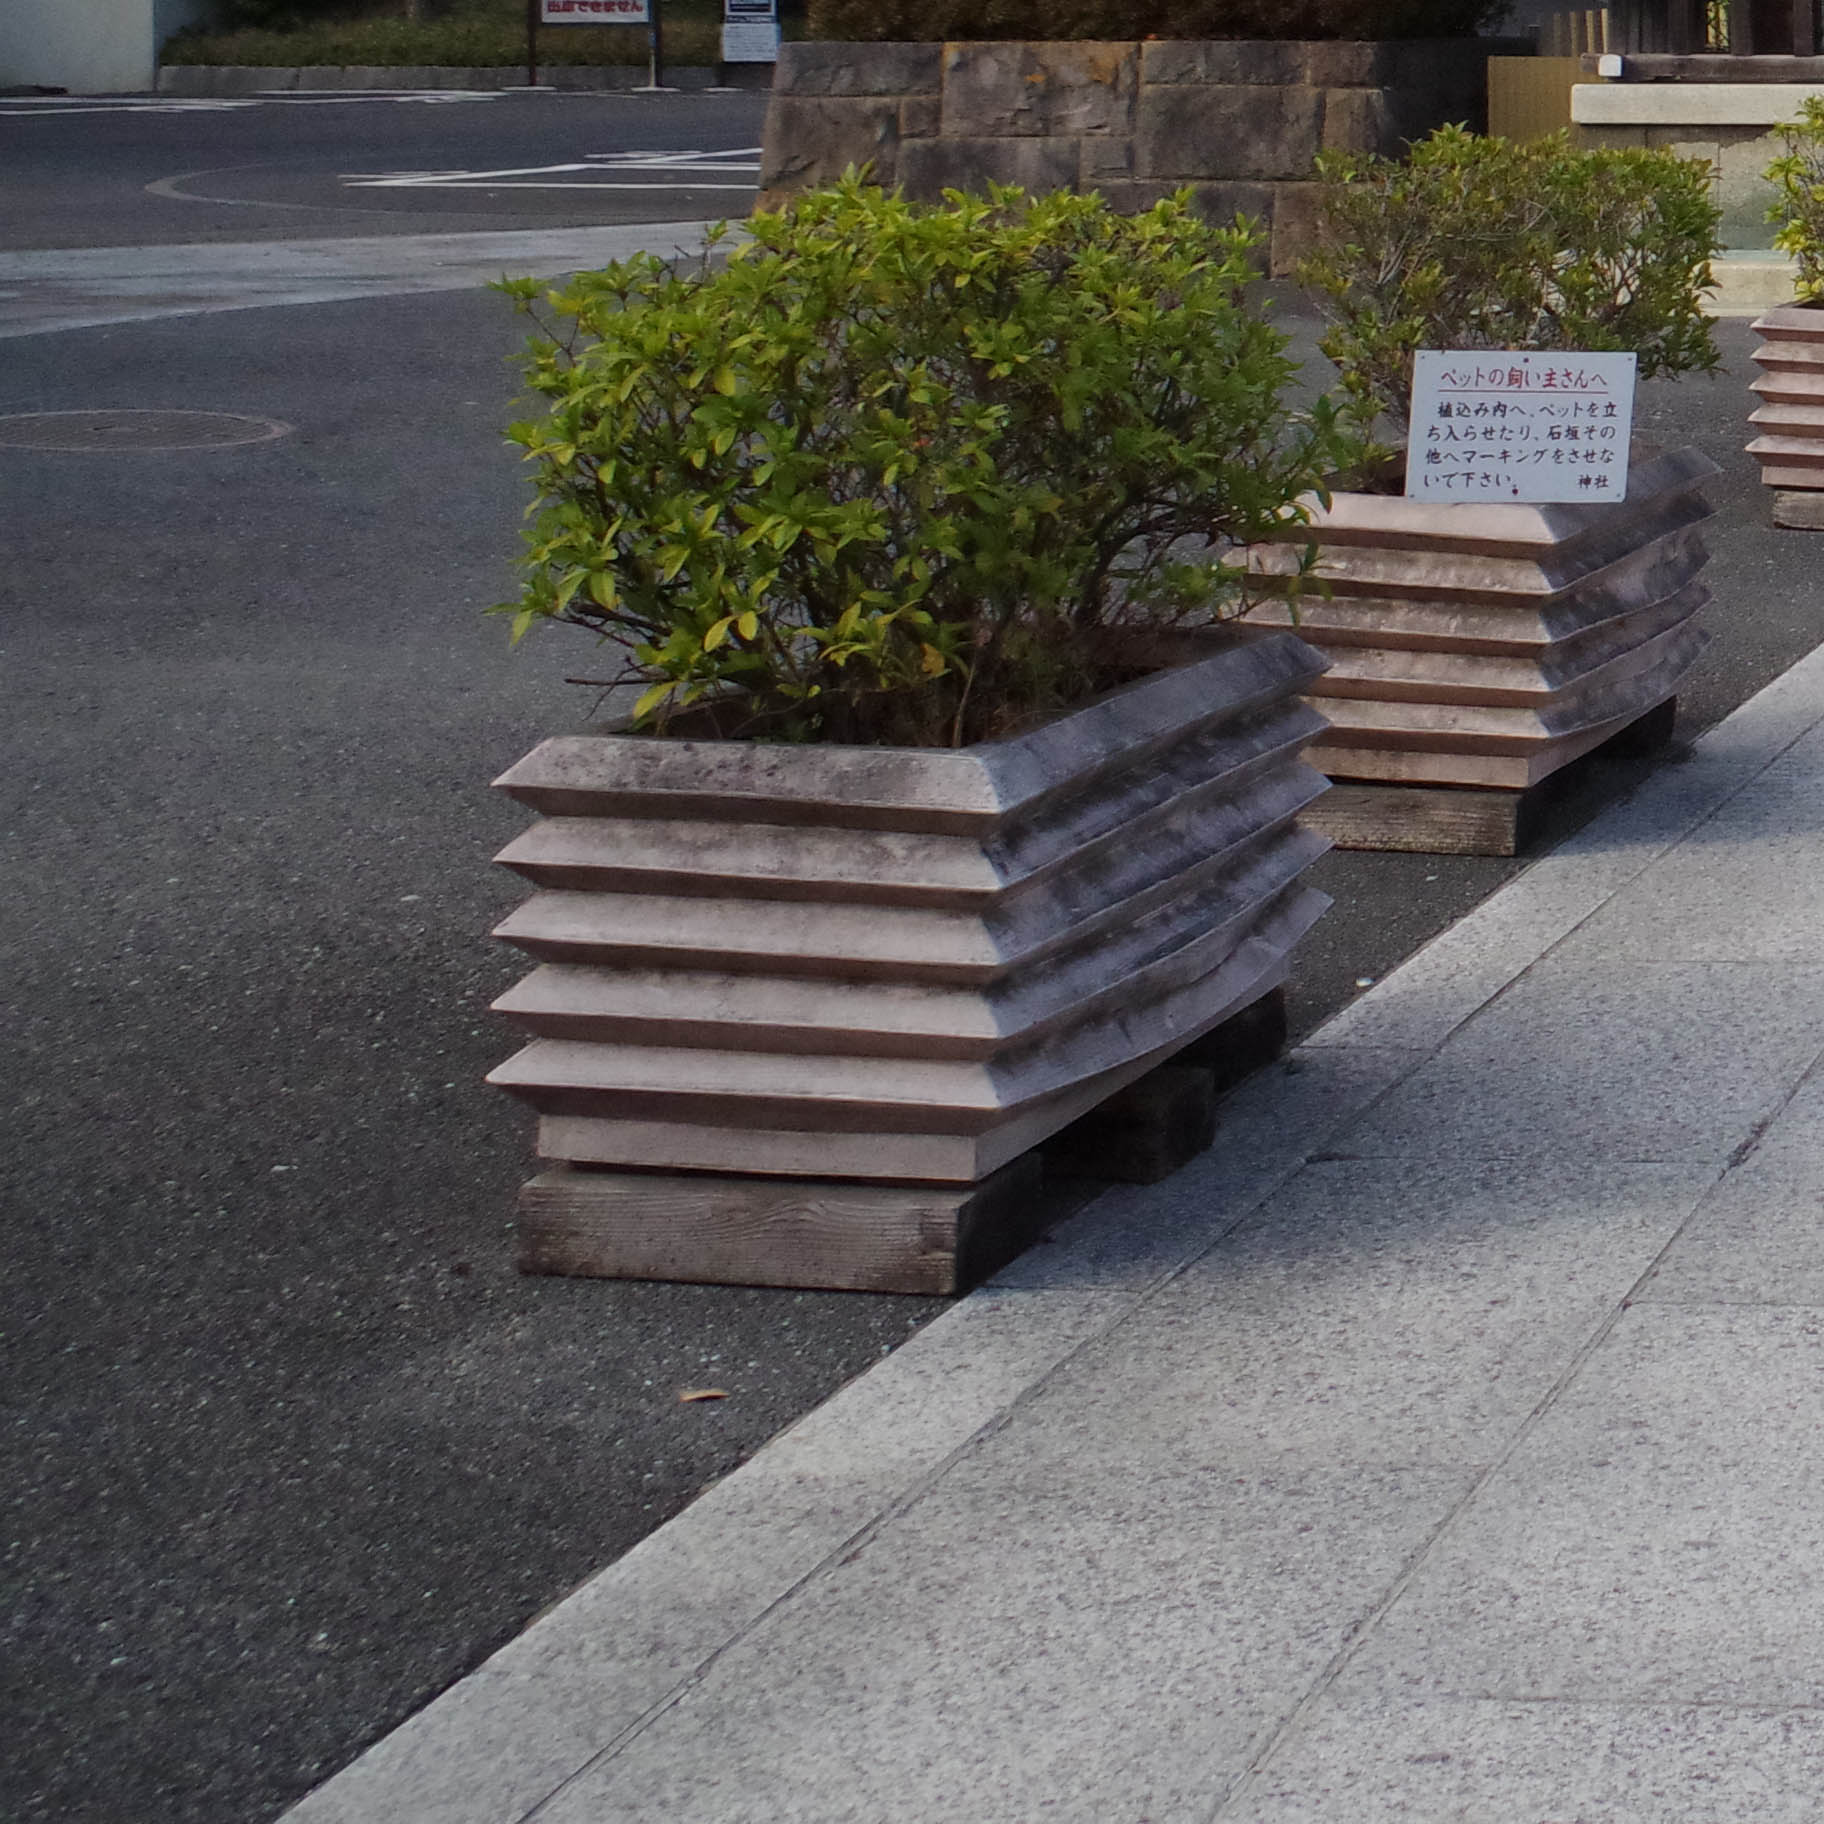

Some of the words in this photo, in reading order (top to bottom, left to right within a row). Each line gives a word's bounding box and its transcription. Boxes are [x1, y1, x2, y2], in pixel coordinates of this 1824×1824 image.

[1440, 365, 1609, 390] ペットの飼い主さんへ
[1426, 424, 1617, 442] ち入らせたり、石垣その
[1425, 447, 1616, 465] 他へマーキングをさせな
[1577, 474, 1610, 490] 神社
